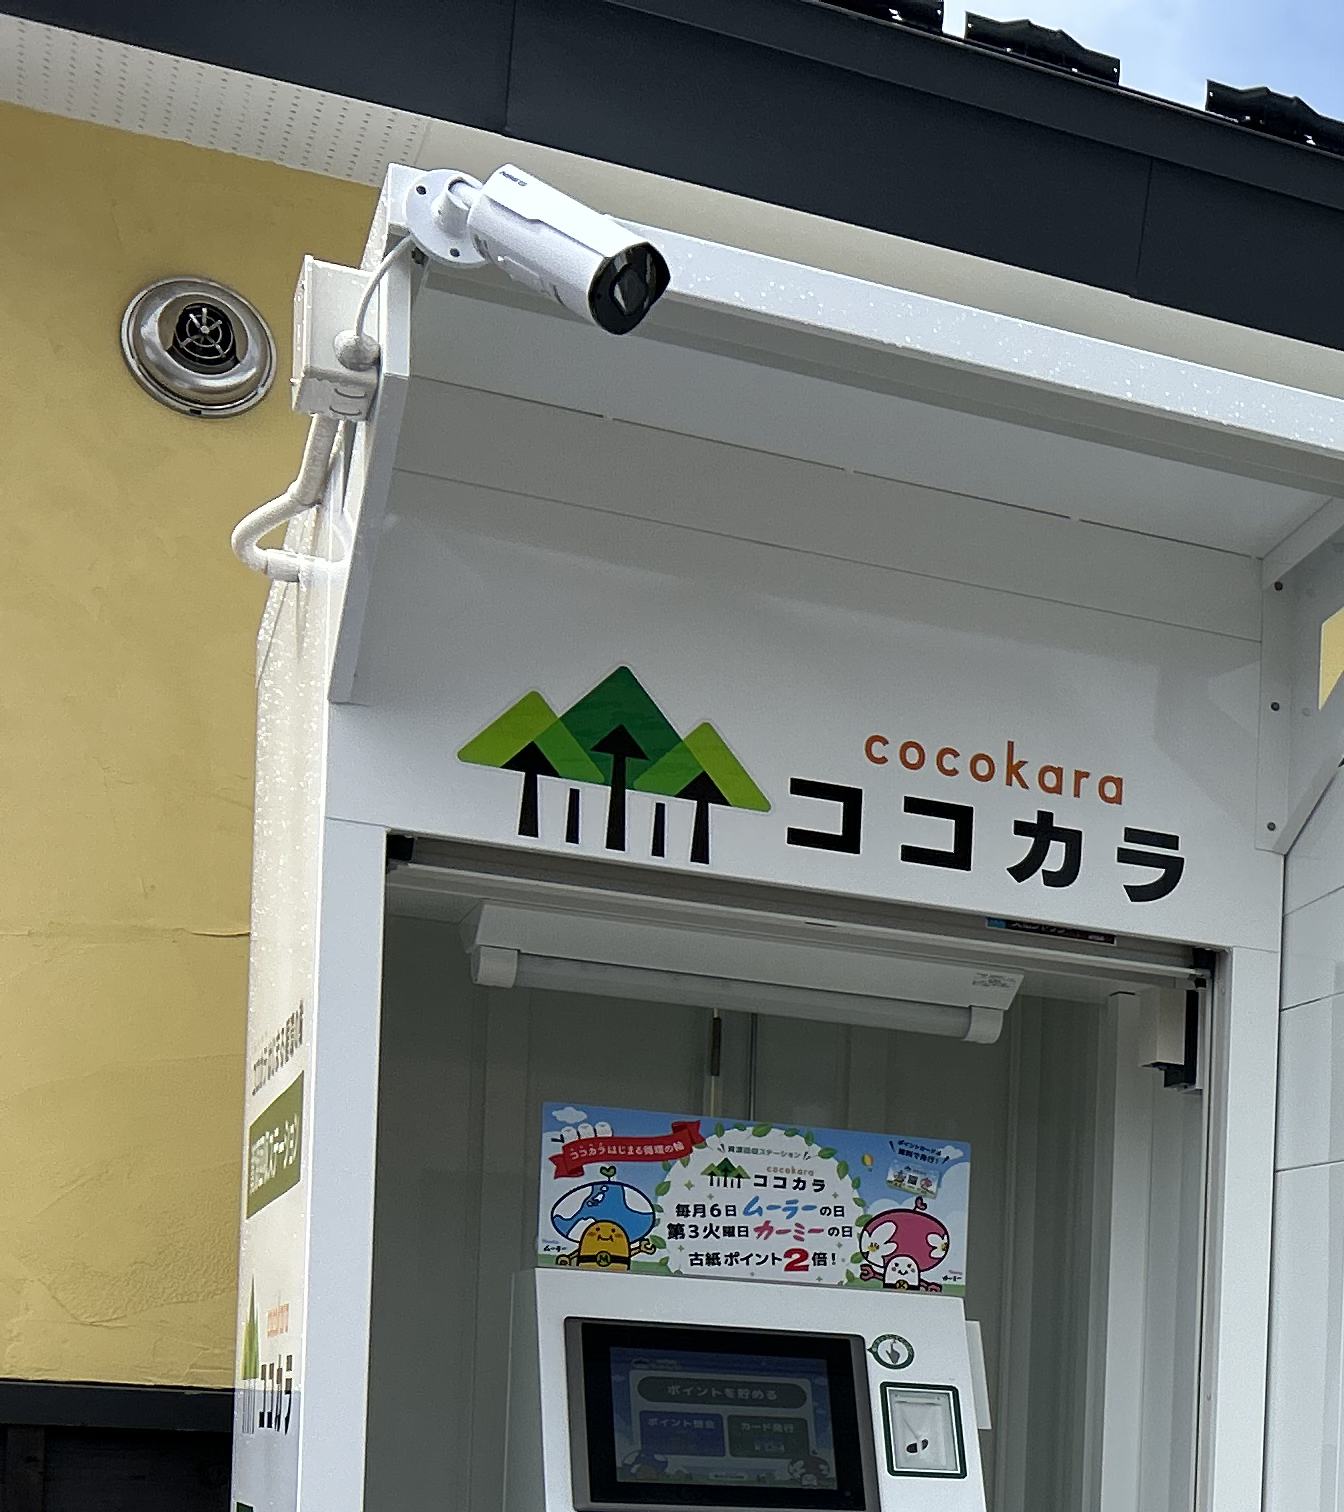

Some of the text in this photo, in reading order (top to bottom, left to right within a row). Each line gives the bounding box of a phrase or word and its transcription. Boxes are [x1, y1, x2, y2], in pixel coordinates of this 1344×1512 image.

[864, 733, 1124, 806] cocokara
[787, 777, 1185, 904] ココカラ
[754, 1174, 826, 1193] ココカラ
[767, 1166, 814, 1177] cocokara
[689, 1248, 836, 1271] 古紙ポイント2倍!
[259, 1354, 293, 1434] ココカラ
